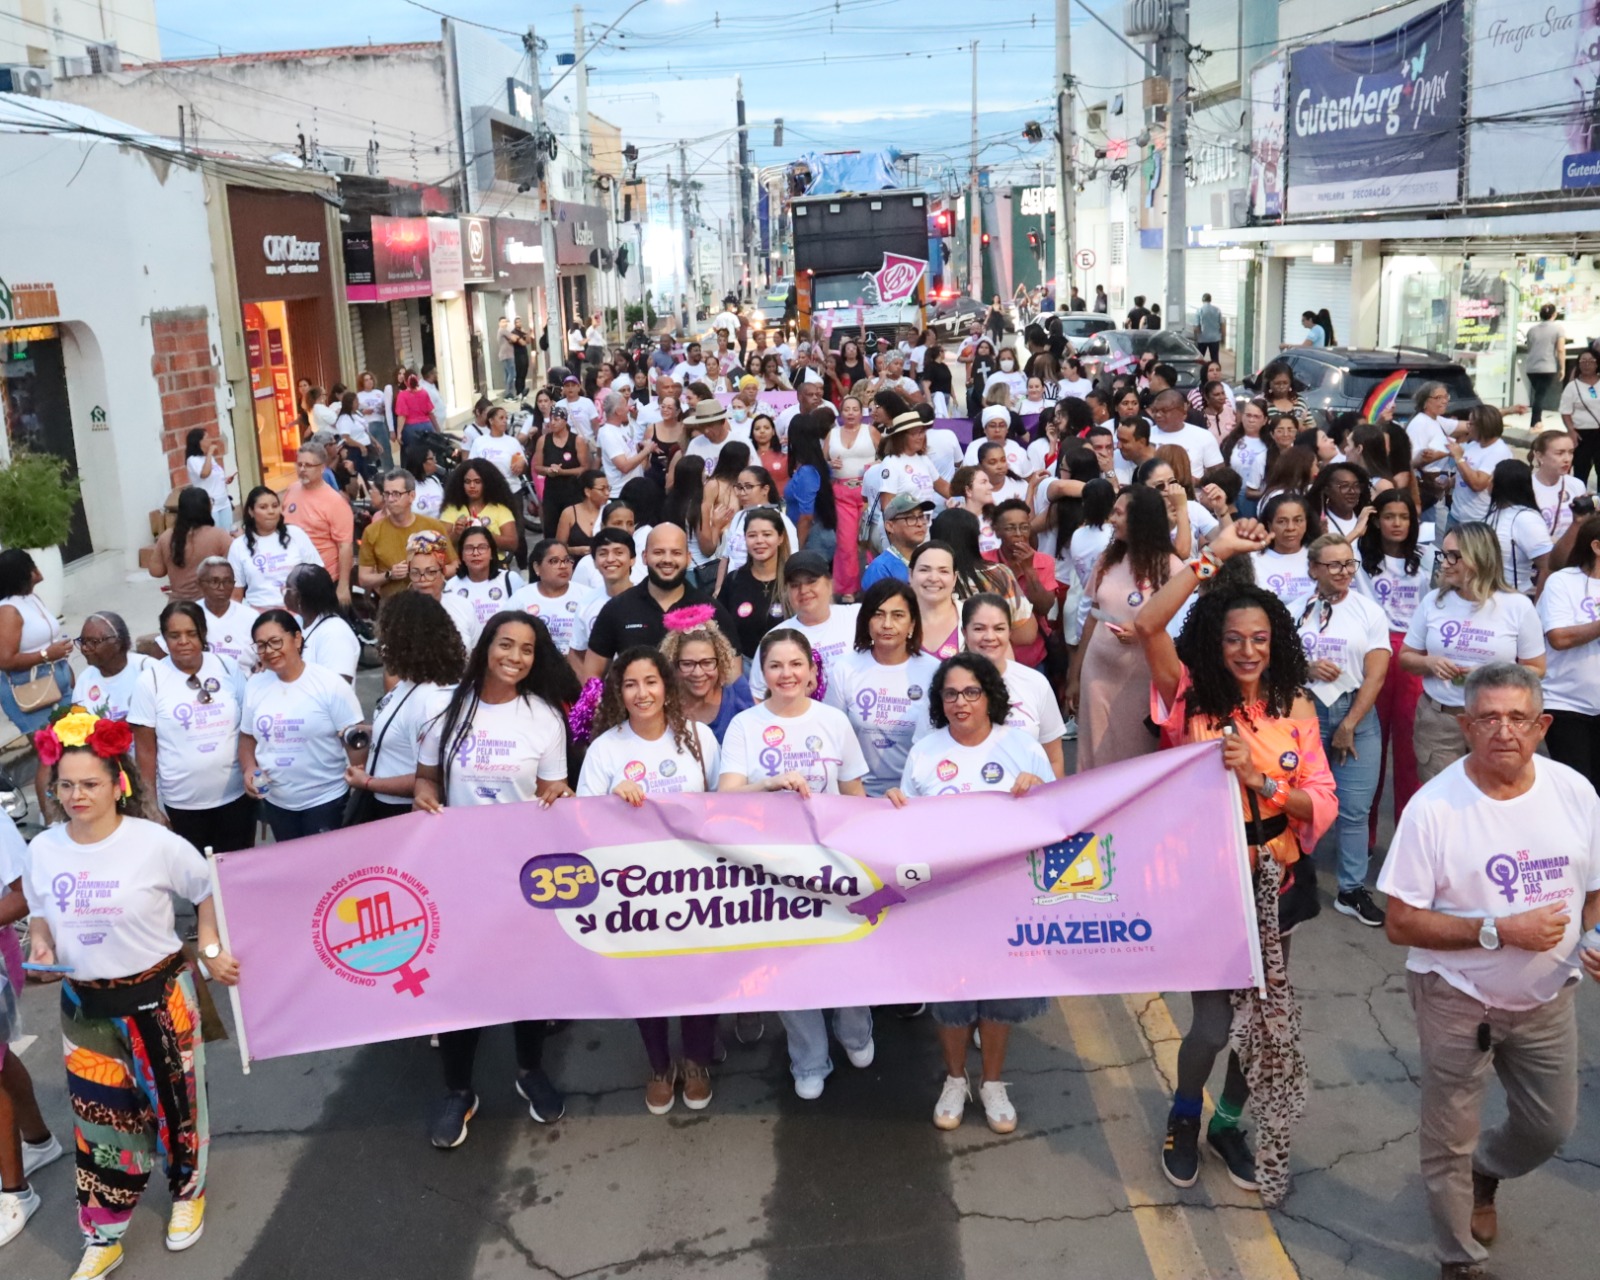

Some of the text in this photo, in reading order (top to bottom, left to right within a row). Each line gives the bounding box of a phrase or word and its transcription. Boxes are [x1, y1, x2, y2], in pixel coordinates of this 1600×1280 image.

[1540, 5, 1573, 38] Sua
[1295, 76, 1404, 137] Gutenberg
[1352, 186, 1391, 199] DECORAÇÃO
[1460, 633, 1488, 643] PELA VIDA
[1461, 627, 1495, 637] CAMINHADA
[877, 696, 911, 706] CAMINHADA
[876, 703, 906, 713] PELA VIDA
[876, 711, 888, 719] DAS
[477, 739, 517, 749] CAMINHADA
[476, 747, 510, 756] PELA VIDA
[783, 751, 820, 760] CAMINHADA
[475, 755, 490, 764] DAS
[784, 760, 815, 768] PELA VIDA
[650, 775, 688, 788] CAMINHADA
[1519, 856, 1570, 872] CAMINHADA
[348, 866, 385, 881] DIREITOS
[387, 866, 398, 876] DA
[1521, 868, 1563, 884] PELA VIDA
[601, 857, 860, 898] Caminhada
[77, 880, 120, 889] CAMINHADA
[332, 878, 348, 893] DOS
[399, 871, 429, 897] MULHER
[1524, 883, 1542, 895] DAS
[75, 889, 112, 898] PELA VIDA
[1523, 887, 1574, 906] MULHERES
[75, 898, 90, 908] DAS
[314, 891, 333, 917] DEFESA
[73, 907, 124, 918] MULHERES
[605, 888, 831, 934] da Mulher
[1015, 912, 1141, 922] PREFEITURA
[312, 919, 320, 929] DE
[1007, 918, 1152, 947] JUAZEIRO
[312, 930, 337, 970] MUNICIPAL
[1008, 949, 1051, 958] PRESENTE
[1072, 947, 1106, 955] FUTURO
[1125, 945, 1156, 953] GENTE
[335, 967, 377, 987] CONSELHO
